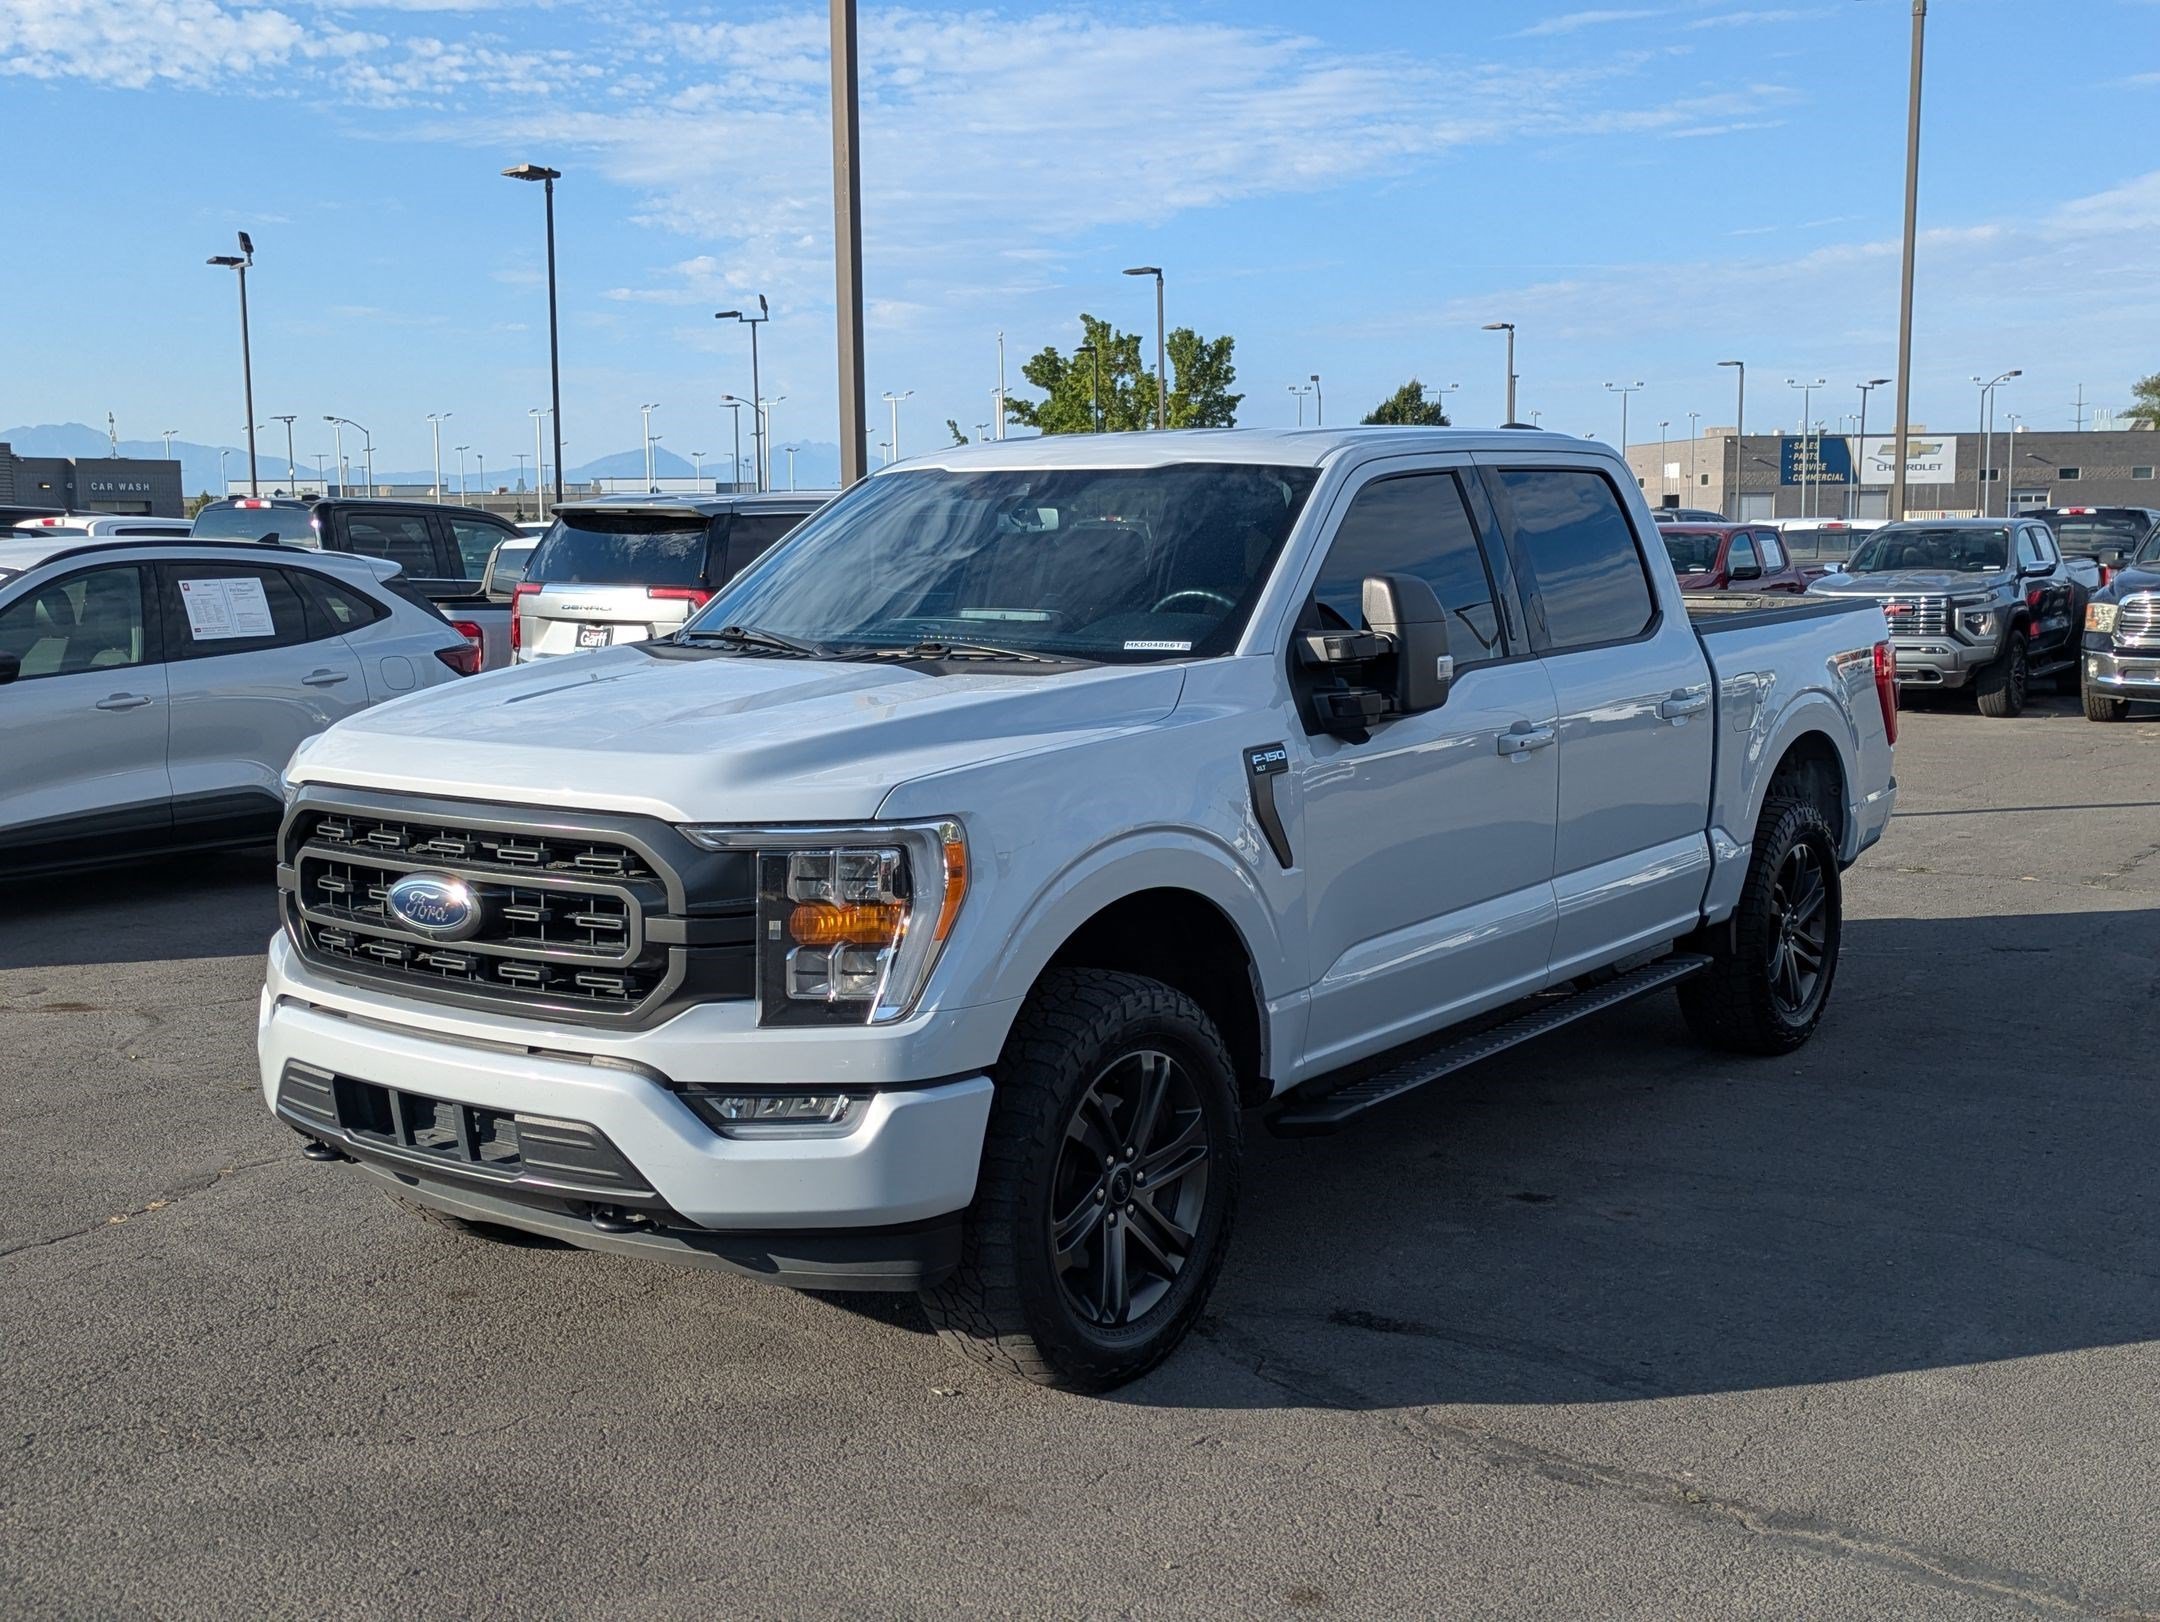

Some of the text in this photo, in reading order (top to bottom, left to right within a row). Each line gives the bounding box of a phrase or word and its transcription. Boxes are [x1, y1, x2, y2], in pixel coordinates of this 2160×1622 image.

[1876, 463, 1943, 472] CHROLET
[90, 482, 150, 491] CAR WASH
[561, 604, 613, 612] DENALI
[1252, 749, 1287, 766] F-150
[1255, 764, 1267, 773] XLT
[405, 890, 450, 922] Ford
